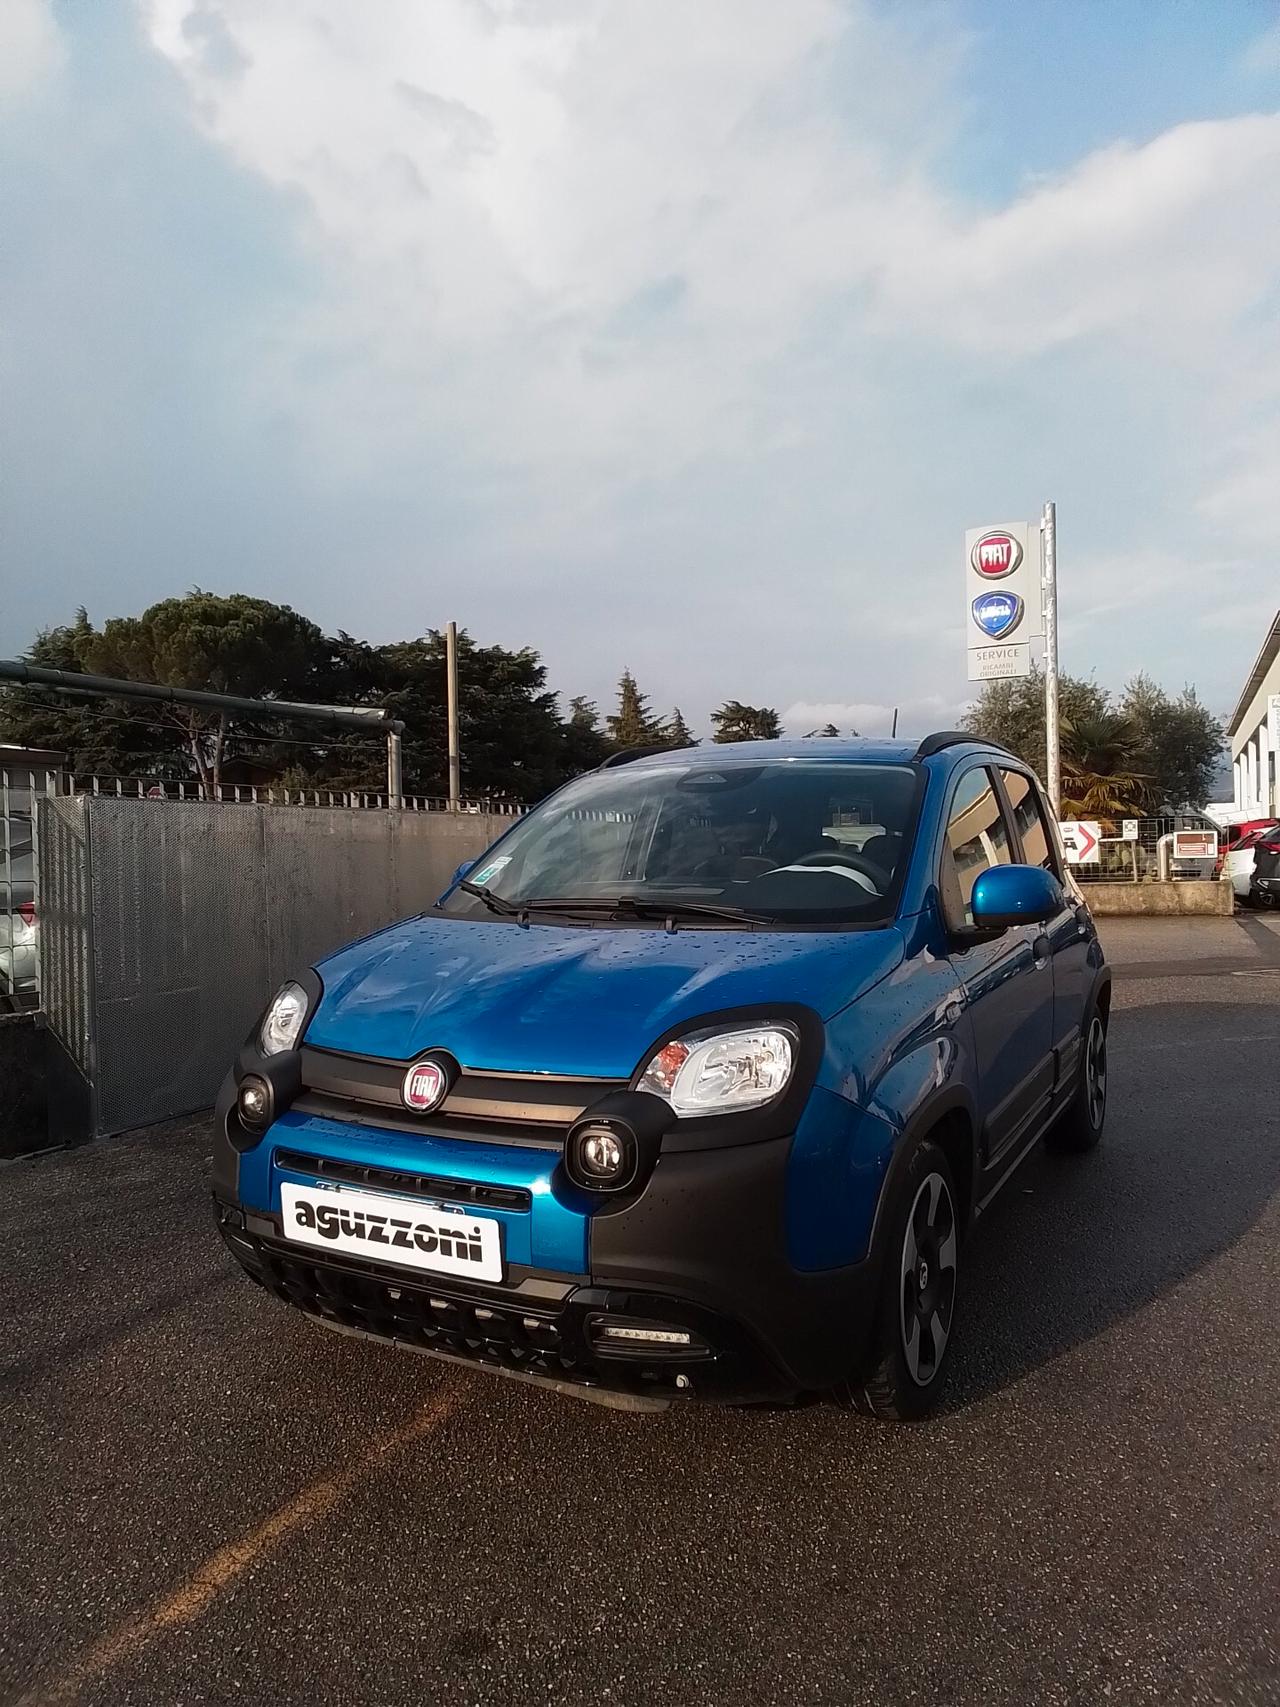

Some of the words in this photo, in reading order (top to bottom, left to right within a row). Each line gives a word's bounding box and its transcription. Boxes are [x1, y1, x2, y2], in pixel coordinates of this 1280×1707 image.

[981, 543, 1010, 567] FIAT
[977, 648, 1020, 661] SERVICE
[411, 1074, 437, 1098] FIAT
[295, 1200, 483, 1263] aguzzoni
